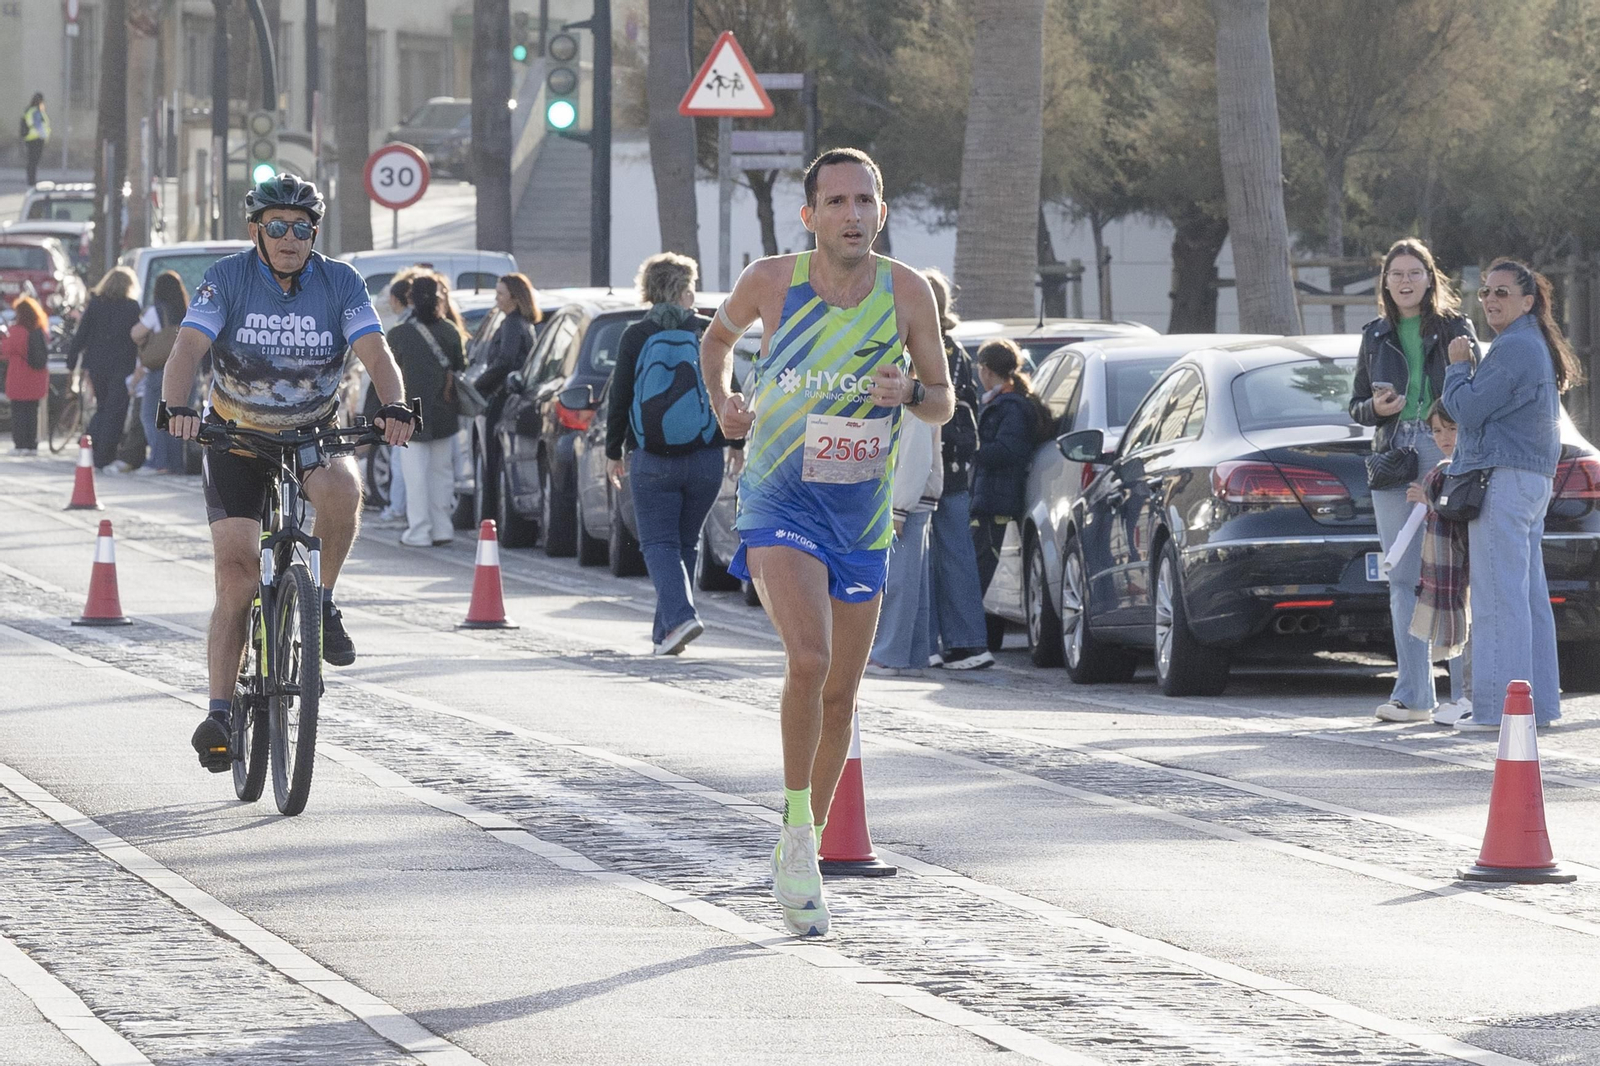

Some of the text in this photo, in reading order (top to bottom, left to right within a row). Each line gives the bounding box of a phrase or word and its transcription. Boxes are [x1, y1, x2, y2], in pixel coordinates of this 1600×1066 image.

[380, 166, 414, 187] 30
[245, 312, 316, 331] media
[235, 327, 333, 347] maraton
[261, 346, 291, 356] CIUDAD
[295, 347, 305, 357] DE
[805, 369, 877, 395] HYGG
[804, 389, 845, 402] RUNNING
[816, 436, 880, 462] 2563
